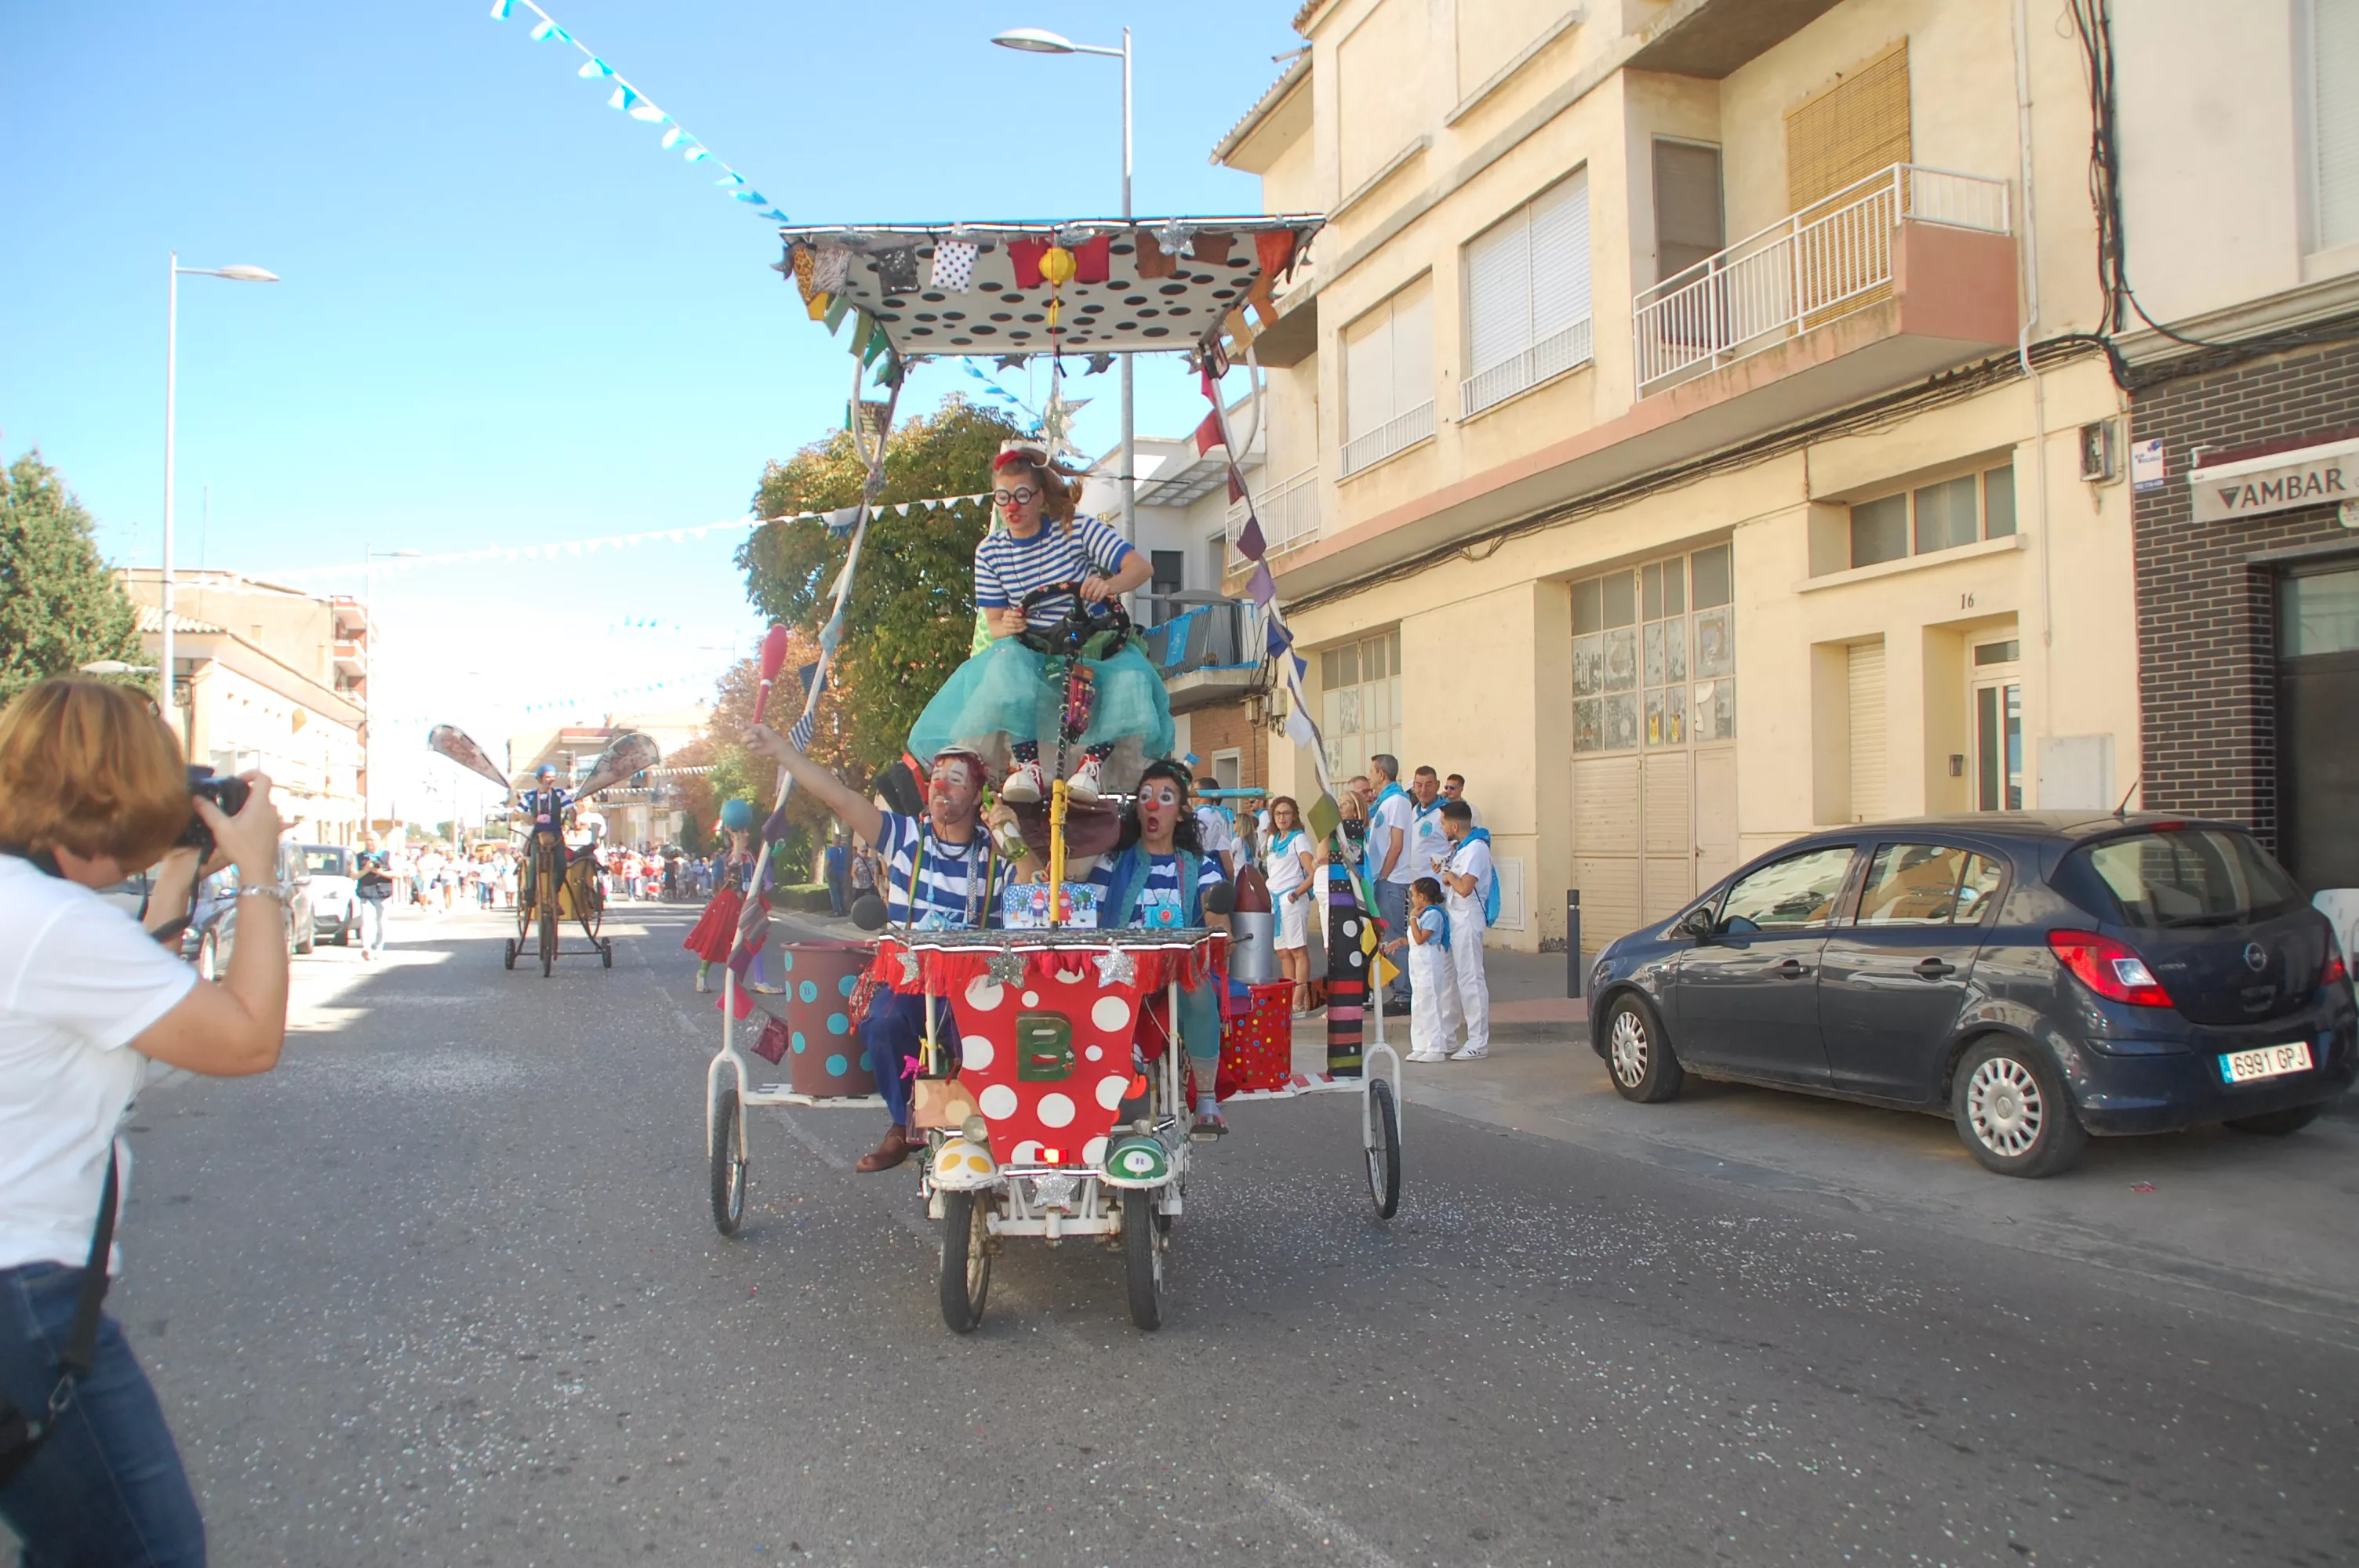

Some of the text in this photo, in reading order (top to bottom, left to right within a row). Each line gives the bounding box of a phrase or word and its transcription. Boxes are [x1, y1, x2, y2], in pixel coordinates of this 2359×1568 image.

[2241, 468, 2346, 508] AMBAR
[1961, 591, 1975, 610] 16
[1016, 1010, 1075, 1082] B
[2235, 1045, 2306, 1076] 6991 GPJ
